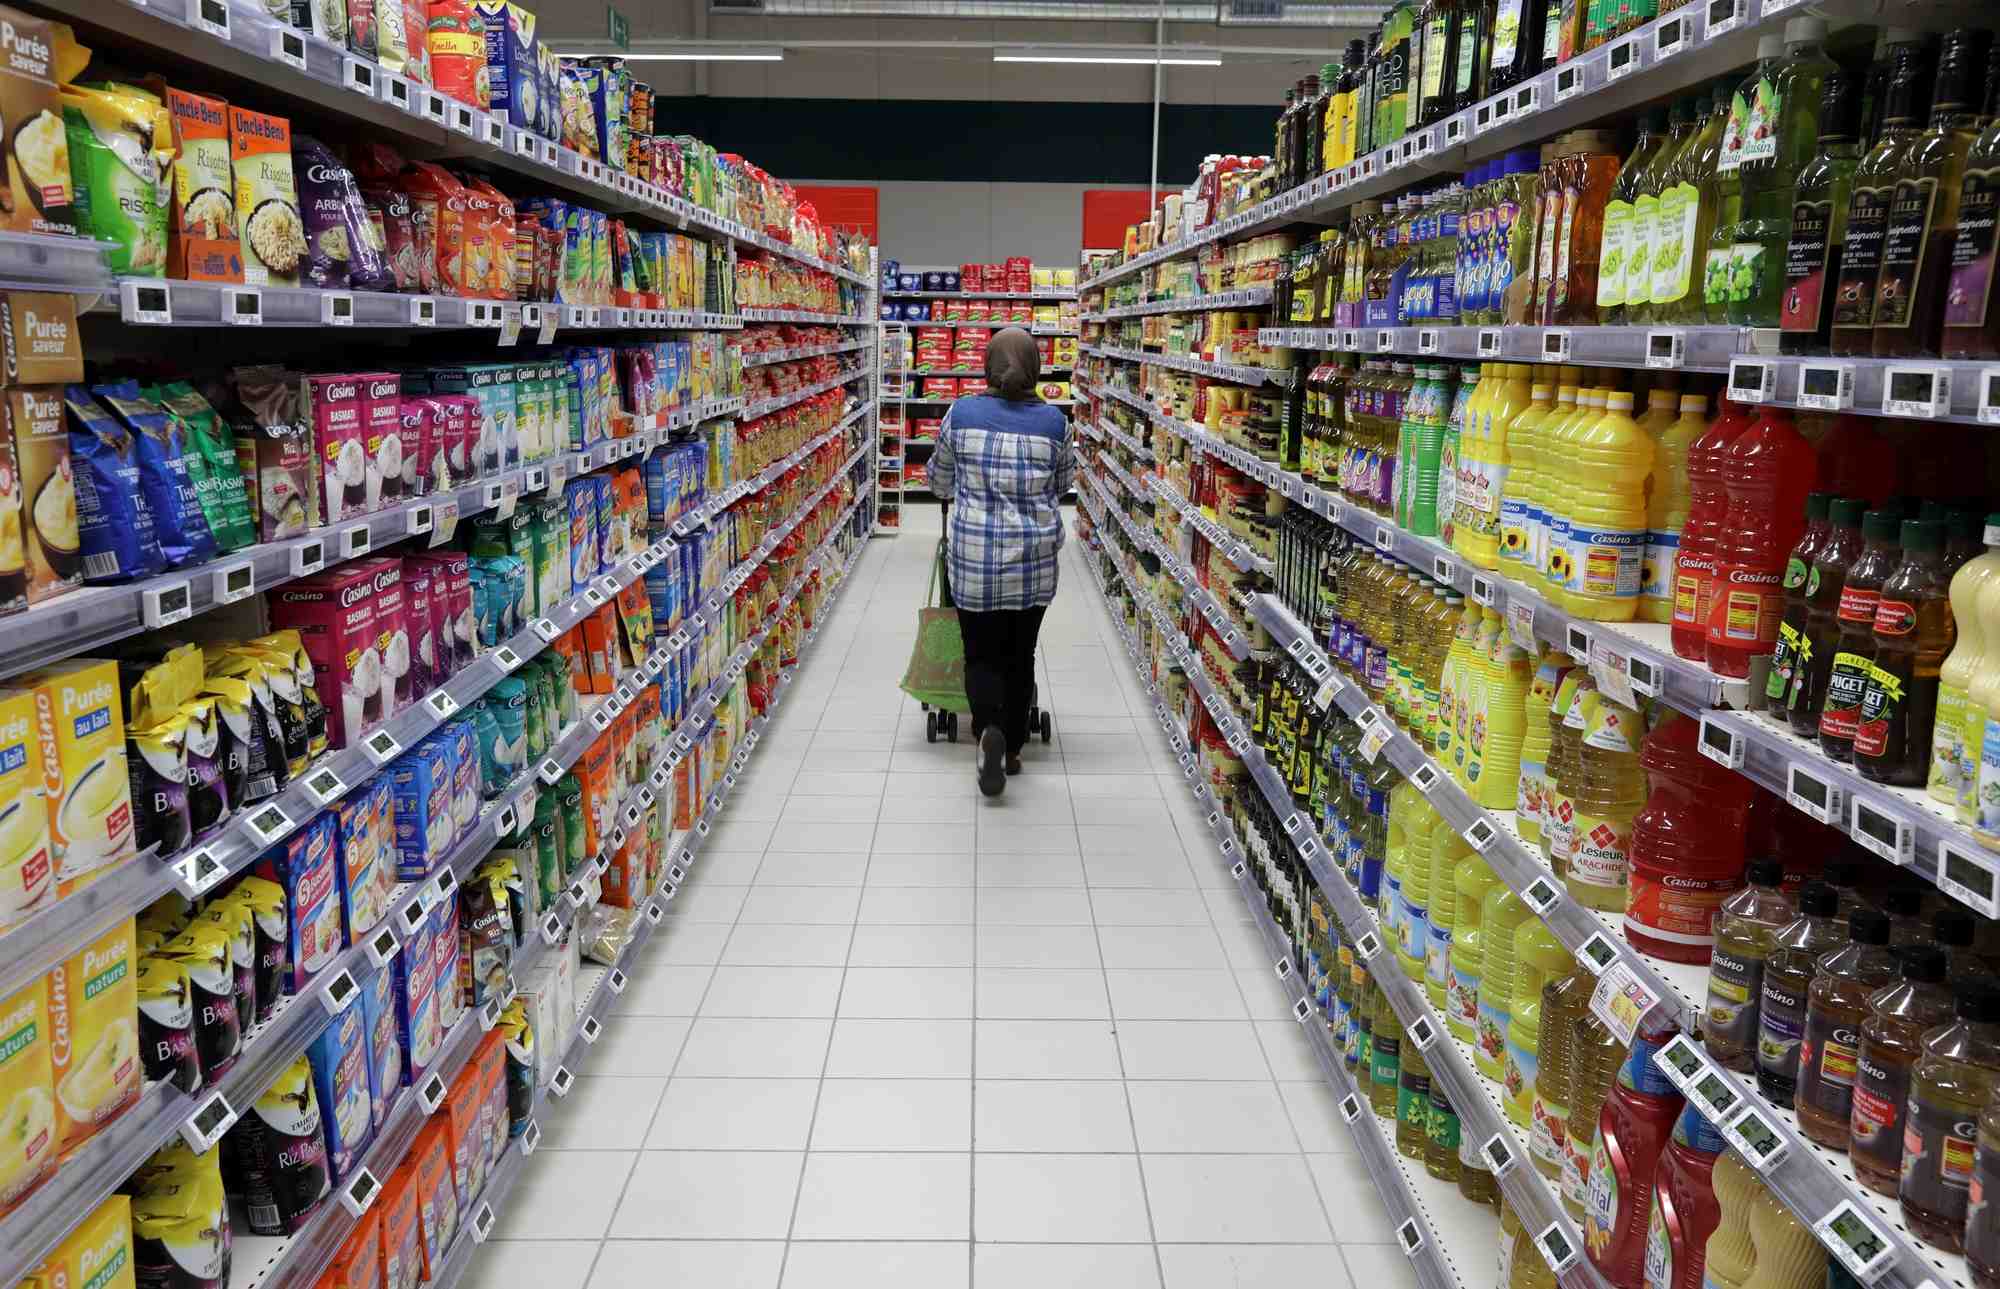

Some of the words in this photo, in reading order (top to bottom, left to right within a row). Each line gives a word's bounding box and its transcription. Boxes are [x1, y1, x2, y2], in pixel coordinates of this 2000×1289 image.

[1, 21, 50, 62] Purée
[9, 53, 48, 76] saveur
[171, 95, 200, 120] Uncle
[235, 112, 264, 136] Uncle
[261, 161, 292, 183] Risotto
[24, 311, 67, 337] Purée
[32, 340, 65, 353] saveur
[327, 383, 356, 402] Casino
[370, 380, 397, 400] Casino
[23, 392, 61, 420] Purée
[330, 409, 356, 422] BASMATI
[373, 405, 396, 418] BASMATI
[1590, 532, 1633, 545] Casino
[1679, 556, 1714, 570] Casino
[374, 568, 401, 593] Casino
[1730, 570, 1780, 584] Casino
[282, 591, 324, 602] Casino
[341, 582, 371, 608] Casino
[347, 606, 372, 625] BASMATI
[62, 680, 113, 716] Purée
[76, 721, 91, 736] au
[91, 710, 110, 730] lait
[4, 746, 25, 766] lait
[37, 694, 64, 799] Casino
[1577, 857, 1625, 872] ARACHIDE
[1663, 875, 1708, 889] Casino
[82, 940, 128, 977] Purée
[87, 964, 127, 998] nature
[48, 965, 71, 1067] Casino
